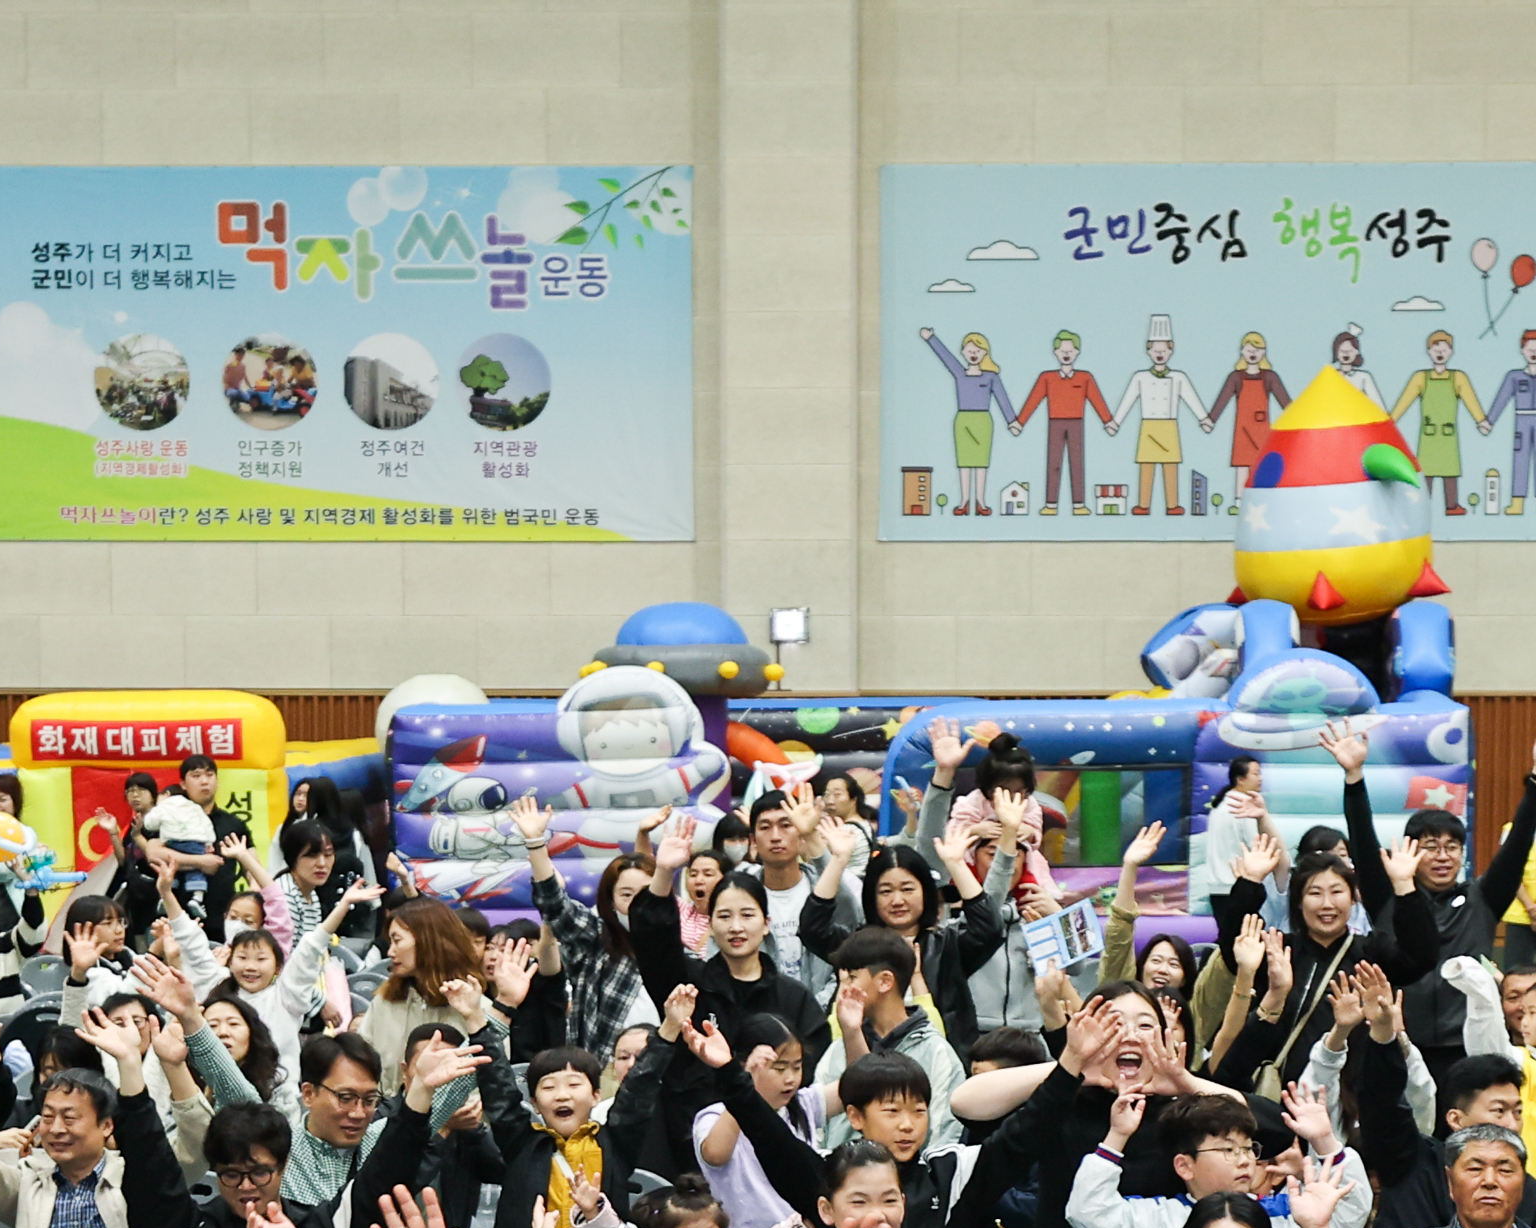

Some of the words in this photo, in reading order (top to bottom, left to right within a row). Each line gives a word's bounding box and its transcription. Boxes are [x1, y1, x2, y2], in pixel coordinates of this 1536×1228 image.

[1063, 202, 1248, 264] 군민중심
[1272, 198, 1452, 284] 행복성주
[31, 241, 94, 263] 성주가
[102, 242, 122, 262] 더
[130, 242, 194, 263] 커지고
[31, 269, 94, 290] 군민이
[102, 269, 122, 290] 더
[130, 268, 238, 291] 행복해지는
[540, 255, 608, 297] 운동
[159, 440, 189, 457] 운동
[238, 440, 303, 457] 인구증가
[360, 440, 425, 457] 정주여건
[473, 440, 538, 458] 지역관광
[238, 461, 303, 479] 정책지원
[377, 461, 409, 478] 개선
[481, 461, 530, 479] 활성화
[60, 506, 189, 525] 먹자쓰놀이란?
[195, 507, 230, 525] 성주
[237, 507, 272, 525] 사랑
[279, 507, 296, 525] 및
[303, 507, 376, 525] 지역경제
[382, 507, 455, 526] 활성화를
[461, 508, 497, 526] 위한
[504, 508, 558, 526] 범국민
[564, 508, 601, 526] 운동
